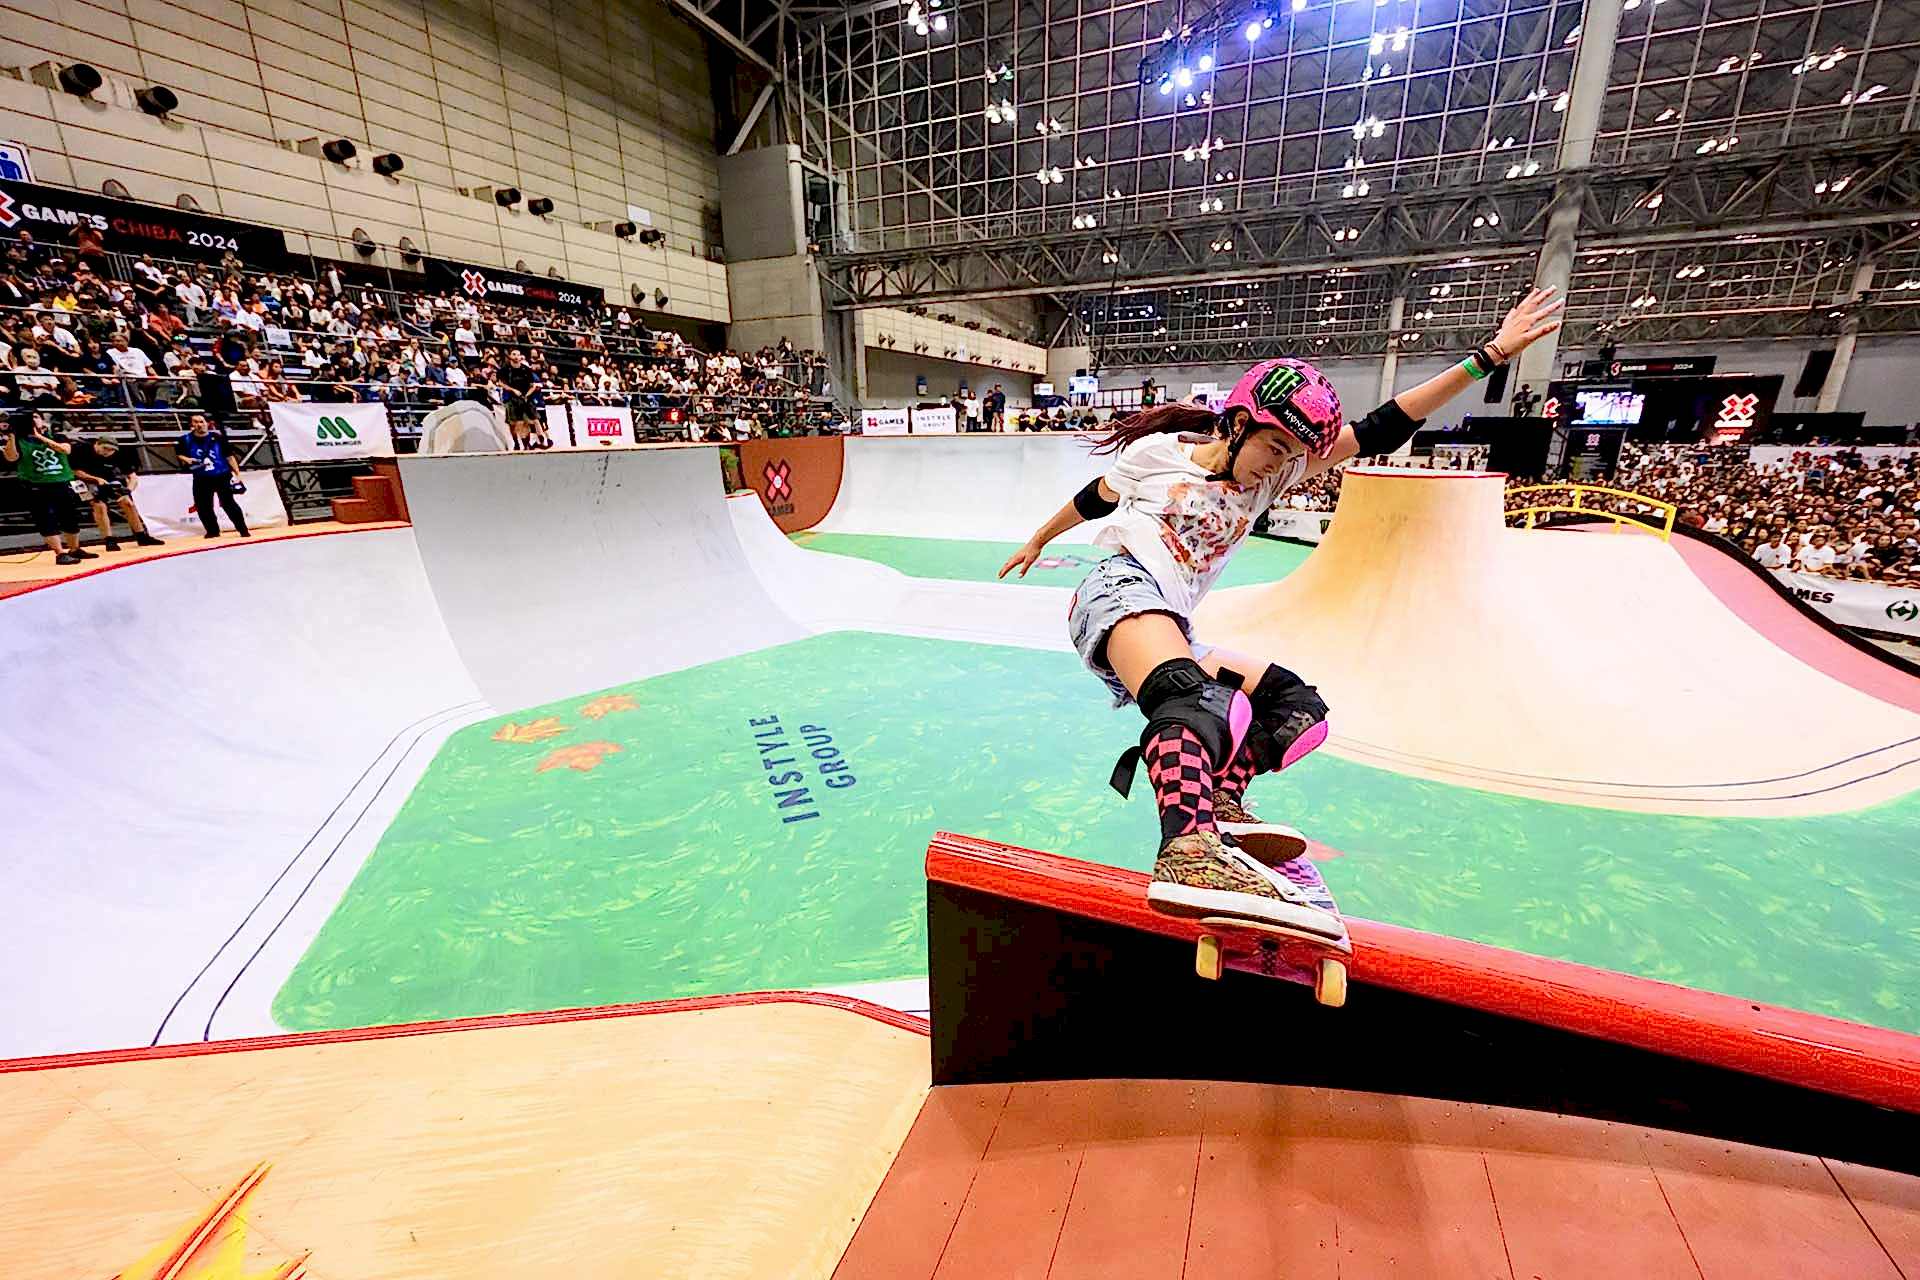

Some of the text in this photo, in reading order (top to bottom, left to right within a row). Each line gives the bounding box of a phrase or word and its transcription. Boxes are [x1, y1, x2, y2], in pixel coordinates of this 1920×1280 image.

[112, 217, 182, 242] CHIBA
[187, 230, 239, 252] 2024
[487, 281, 524, 295] GAMES
[558, 292, 582, 305] 2024
[1283, 409, 1319, 443] MONSTER
[1786, 586, 1835, 604] AMES
[749, 715, 820, 823] INSTYLE
[800, 725, 857, 789] GROUP
